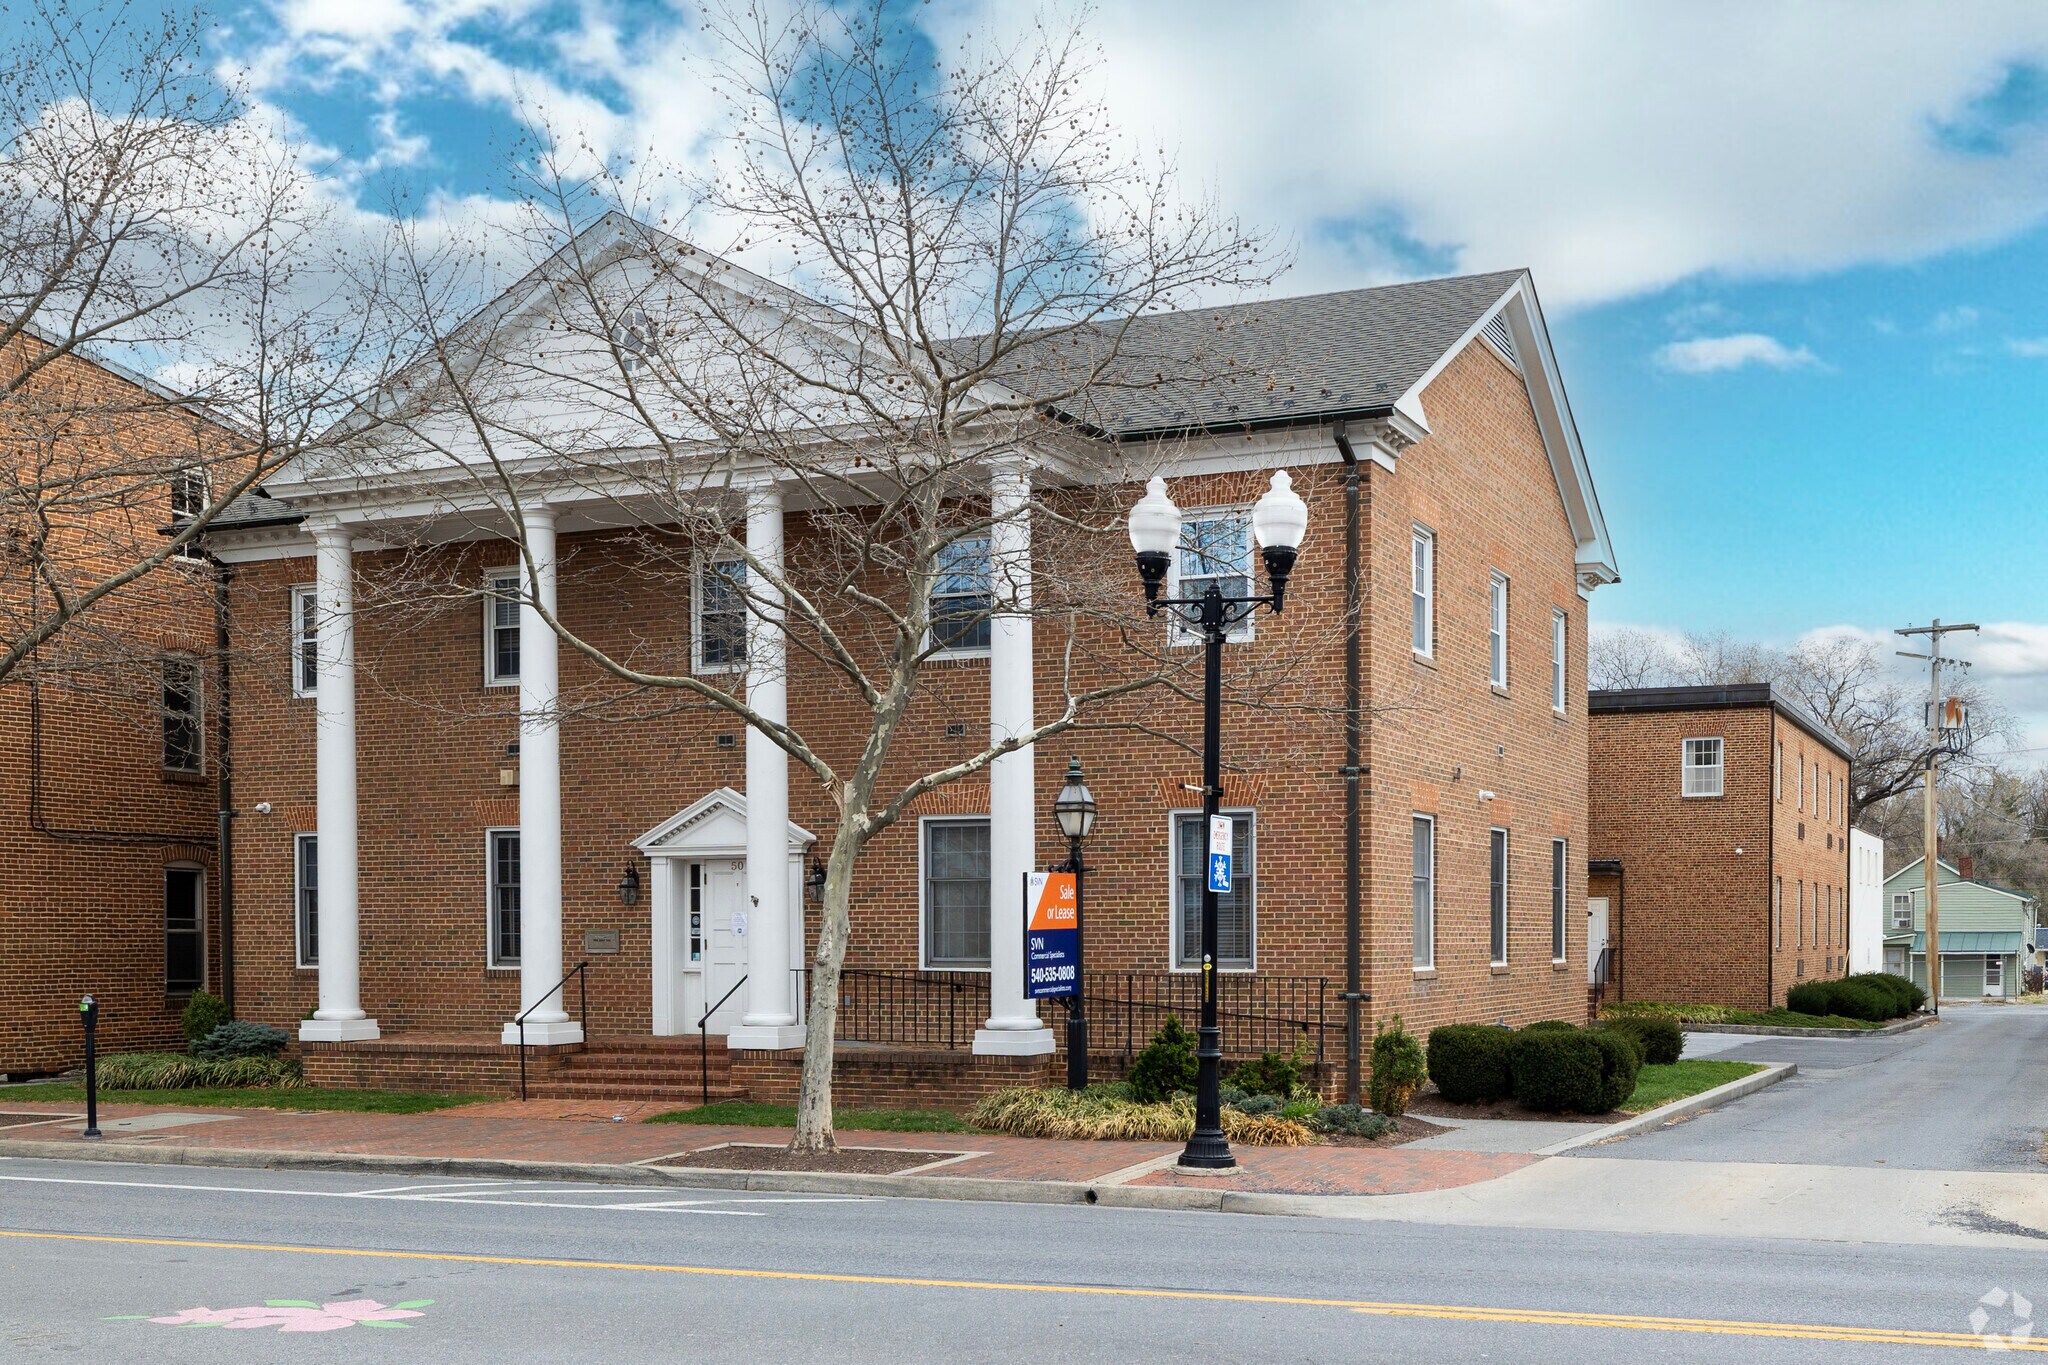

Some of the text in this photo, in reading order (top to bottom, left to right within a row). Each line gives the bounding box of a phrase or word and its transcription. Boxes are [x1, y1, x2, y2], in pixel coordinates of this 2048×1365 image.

[731, 861, 744, 870] 50
[1060, 884, 1074, 899] Sale
[1047, 904, 1074, 919] or Lease
[1031, 937, 1044, 950] SVN
[1031, 965, 1074, 983] 540-535-0808
